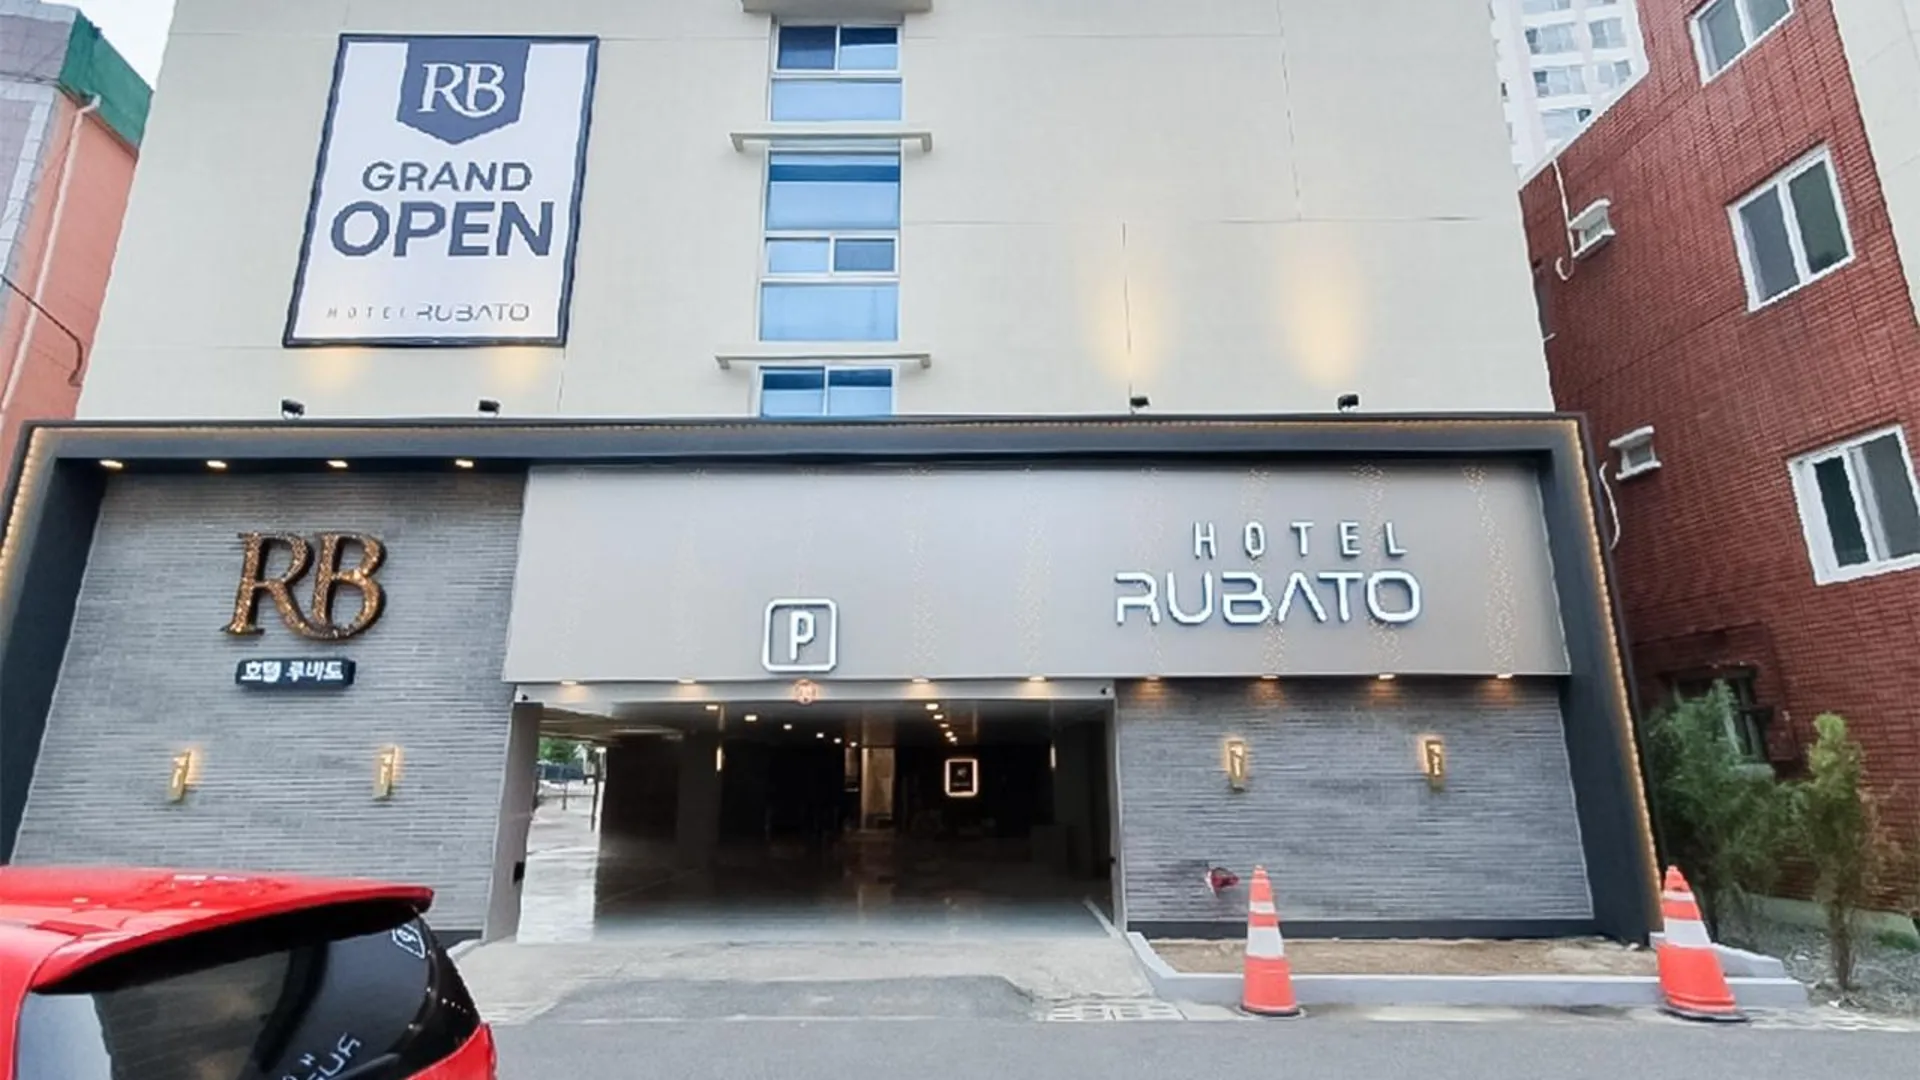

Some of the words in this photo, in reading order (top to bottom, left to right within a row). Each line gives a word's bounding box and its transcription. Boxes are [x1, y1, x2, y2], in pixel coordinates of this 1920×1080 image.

[417, 62, 505, 118] RB
[362, 161, 533, 191] GRAND
[330, 201, 554, 257] OPEN
[416, 303, 530, 322] RUBATO
[1192, 521, 1407, 558] HOTEL
[219, 531, 387, 641] RB
[1114, 571, 1423, 624] RUBATO
[789, 610, 815, 661] P
